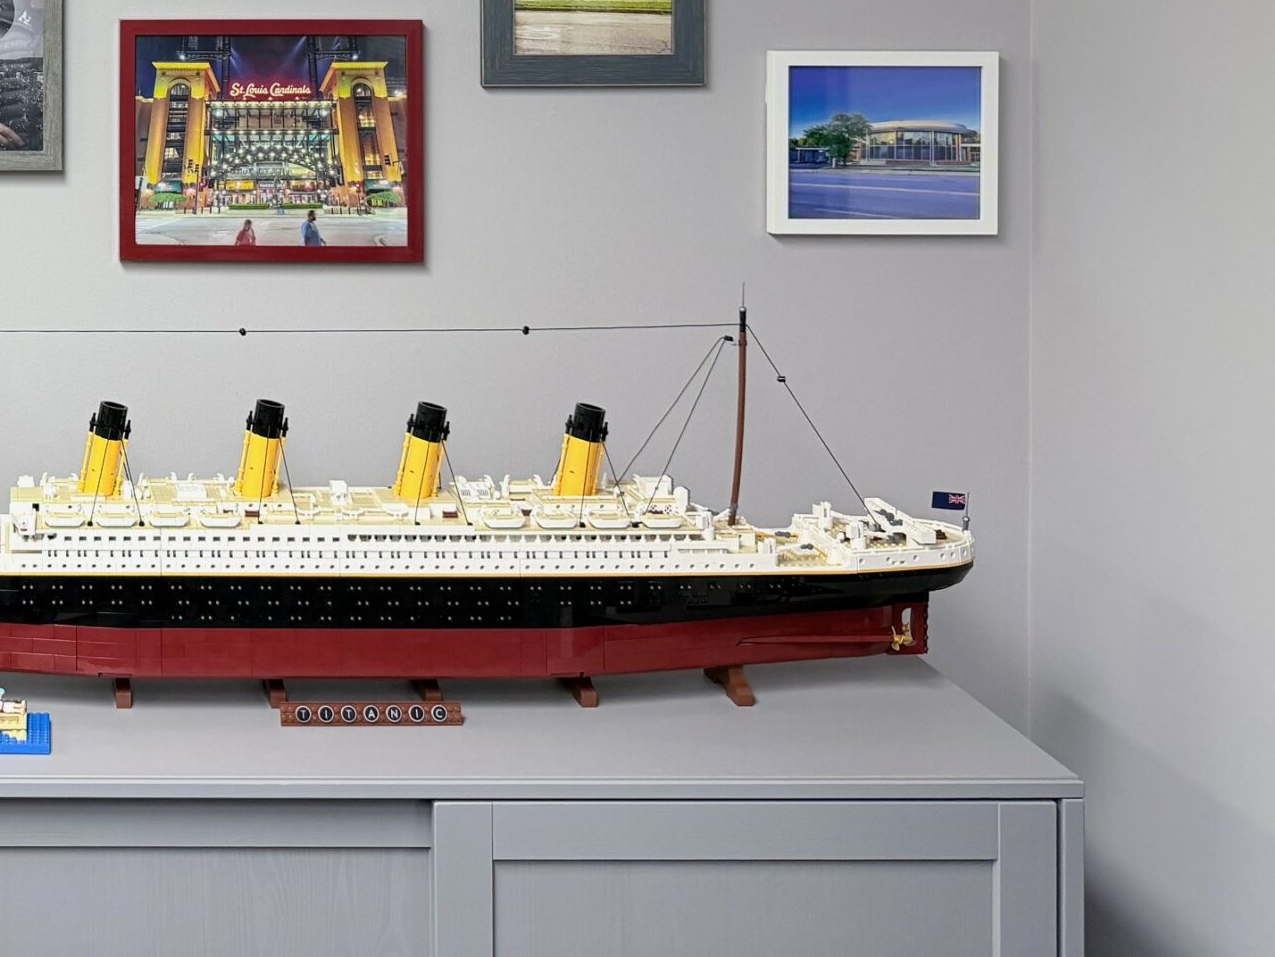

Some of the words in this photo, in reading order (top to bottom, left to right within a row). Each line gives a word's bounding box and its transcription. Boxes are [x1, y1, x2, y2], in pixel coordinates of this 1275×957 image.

[229, 82, 245, 97] St.
[243, 83, 269, 98] Louis
[270, 82, 312, 97] Cardinals
[298, 707, 445, 720] TITANIC
